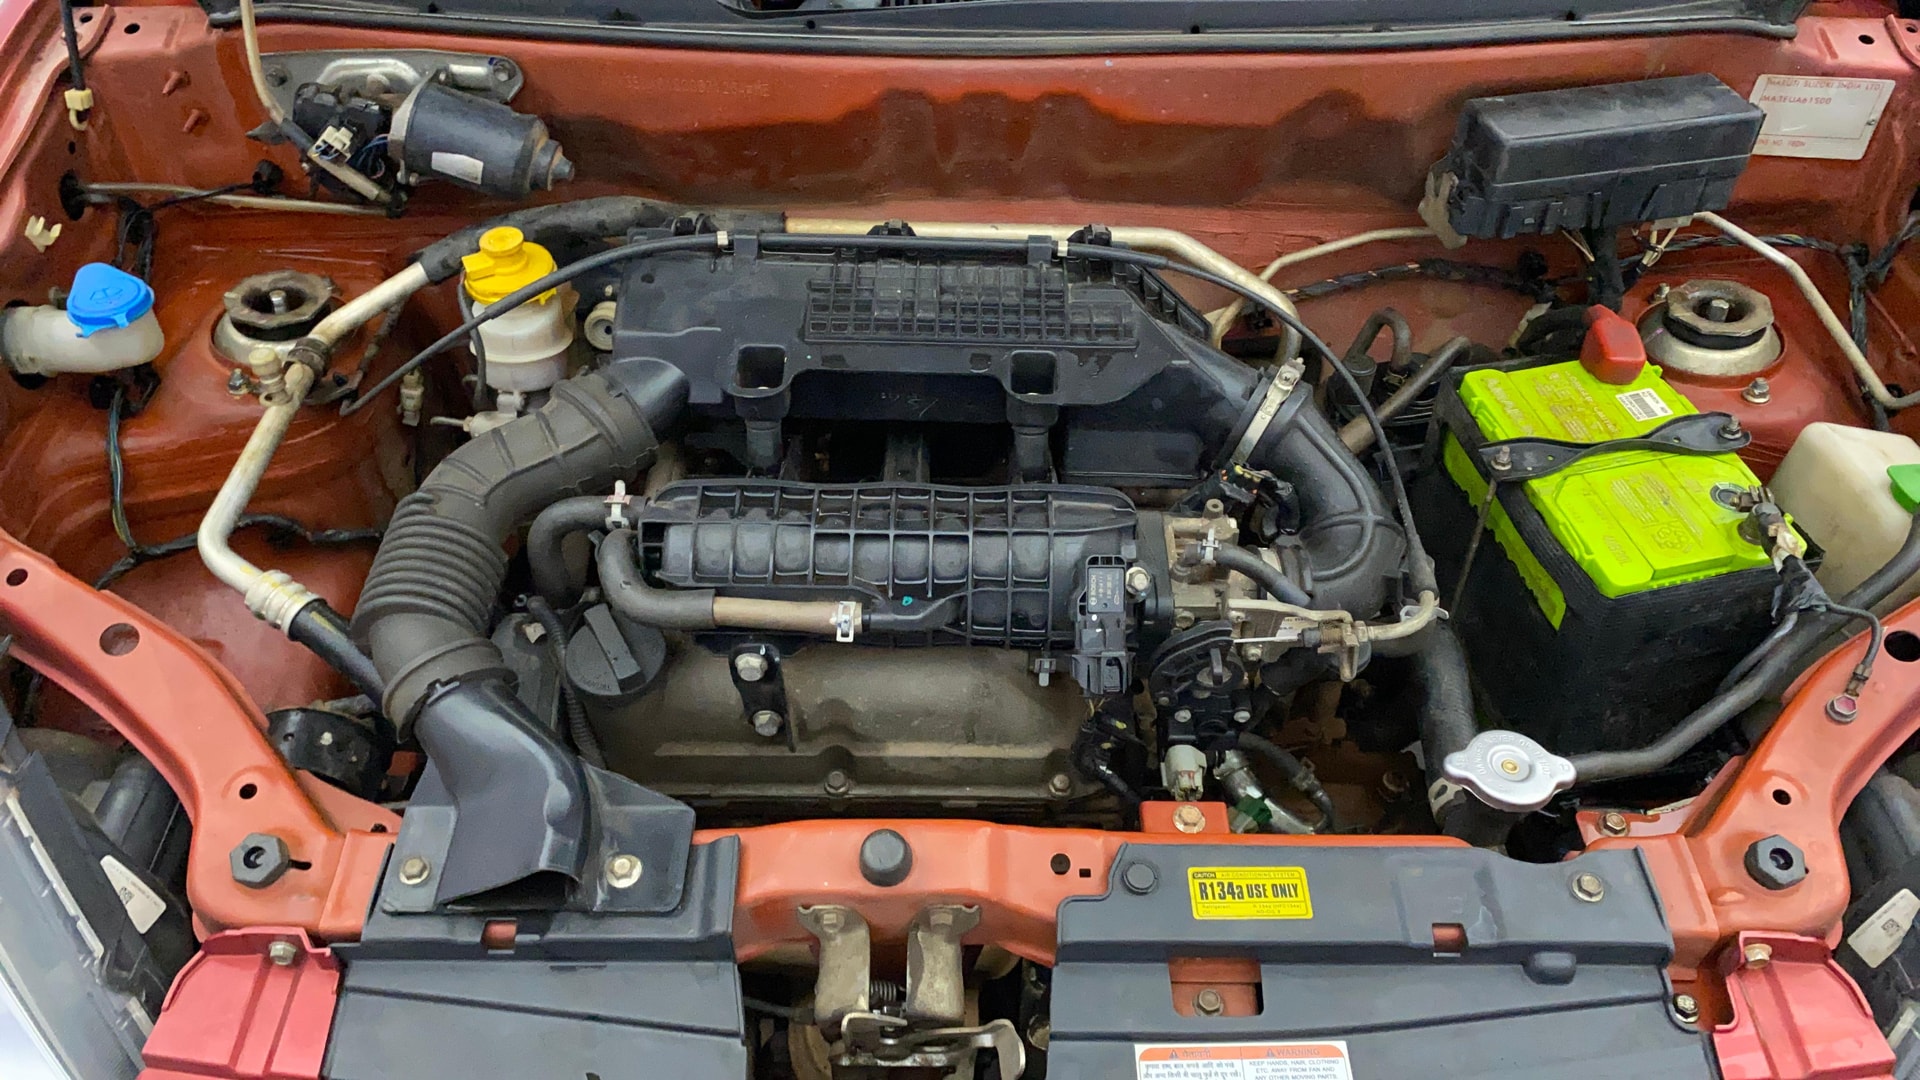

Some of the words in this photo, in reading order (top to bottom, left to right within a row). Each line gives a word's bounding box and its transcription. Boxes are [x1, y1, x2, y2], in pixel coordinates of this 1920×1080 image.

[1768, 79, 1800, 88] MARUTI
[1803, 80, 1834, 89] SUZUKI
[1837, 81, 1861, 90] INDIA
[1198, 881, 1245, 901] R134a
[1246, 883, 1269, 899] USE
[1271, 883, 1299, 898] ONLY
[1276, 1048, 1320, 1056] WARNING
